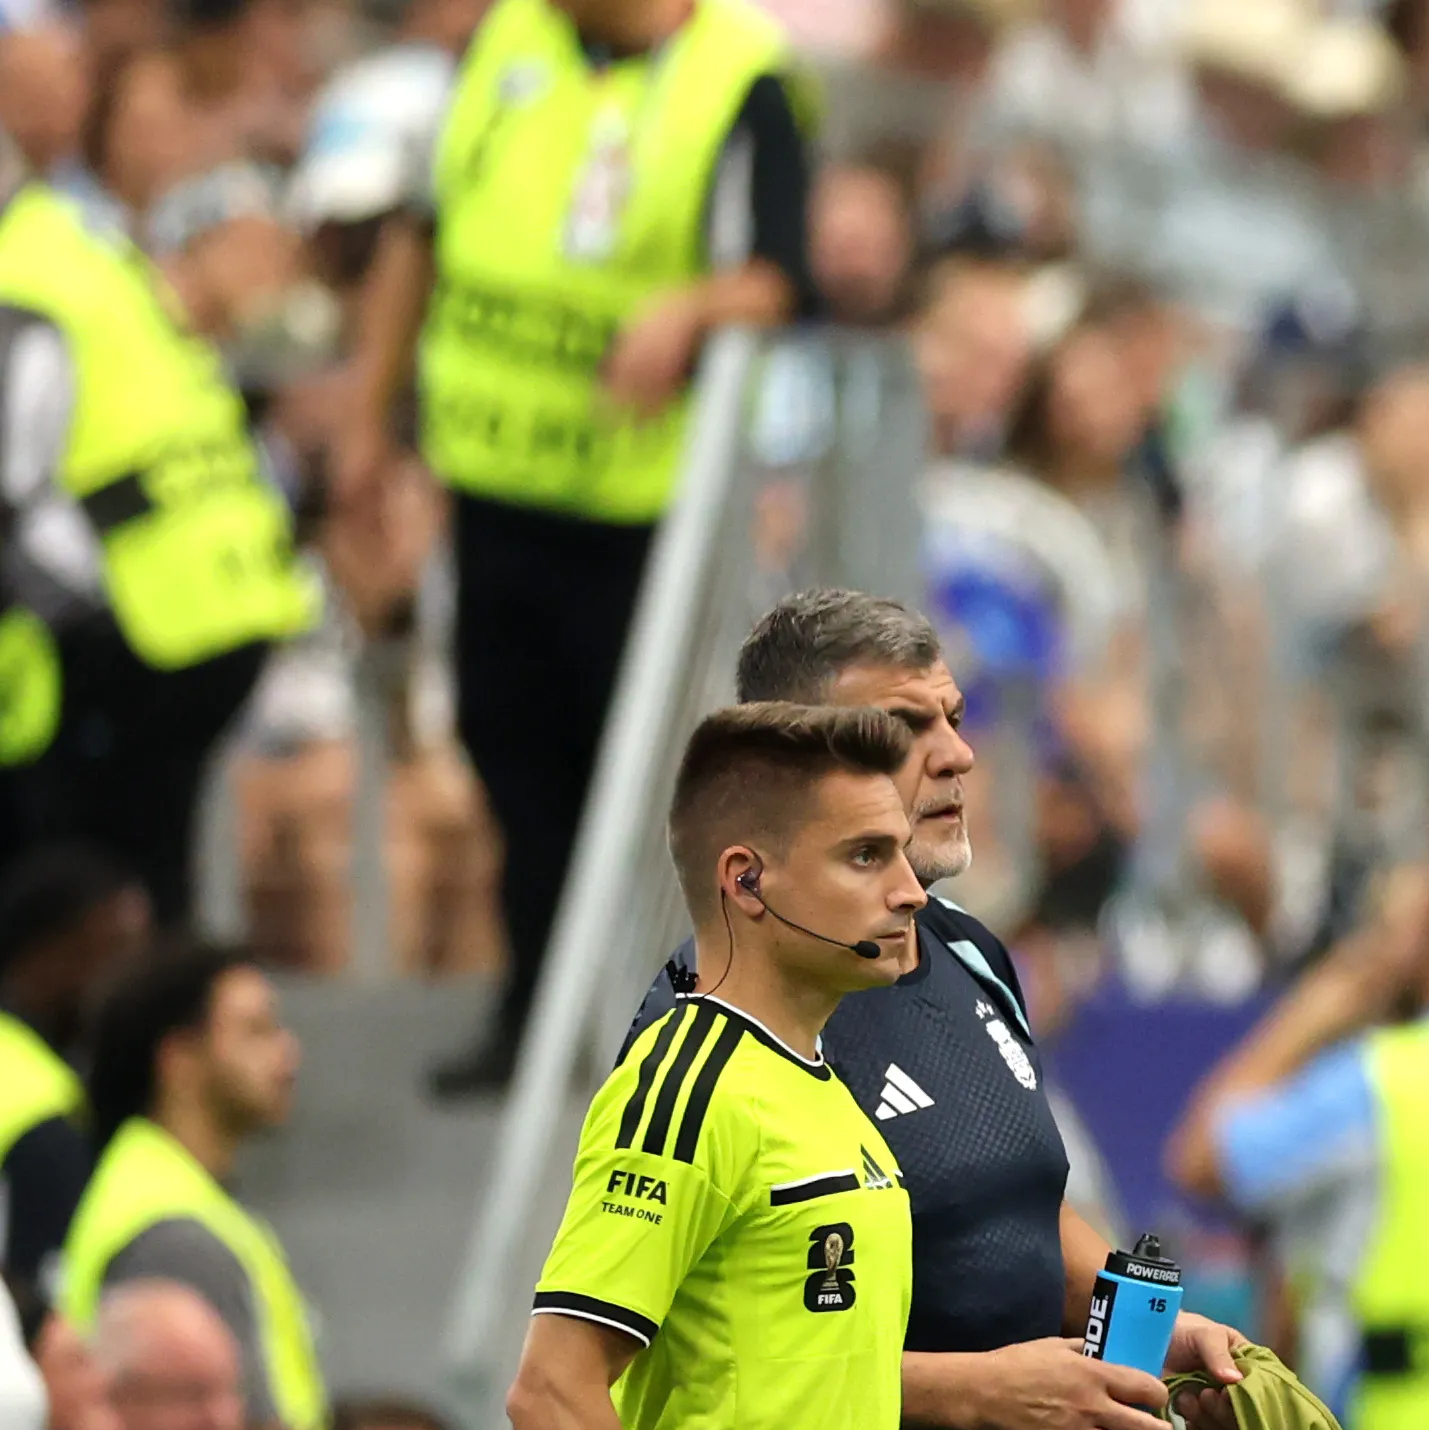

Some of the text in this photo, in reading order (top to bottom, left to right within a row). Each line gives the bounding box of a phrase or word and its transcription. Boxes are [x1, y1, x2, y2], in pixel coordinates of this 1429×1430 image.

[607, 1169, 667, 1206] FIFA
[602, 1202, 663, 1225] TEAM ONE
[1126, 1262, 1181, 1283] POWERADE
[817, 1293, 843, 1305] FIFA
[1148, 1298, 1168, 1313] 15
